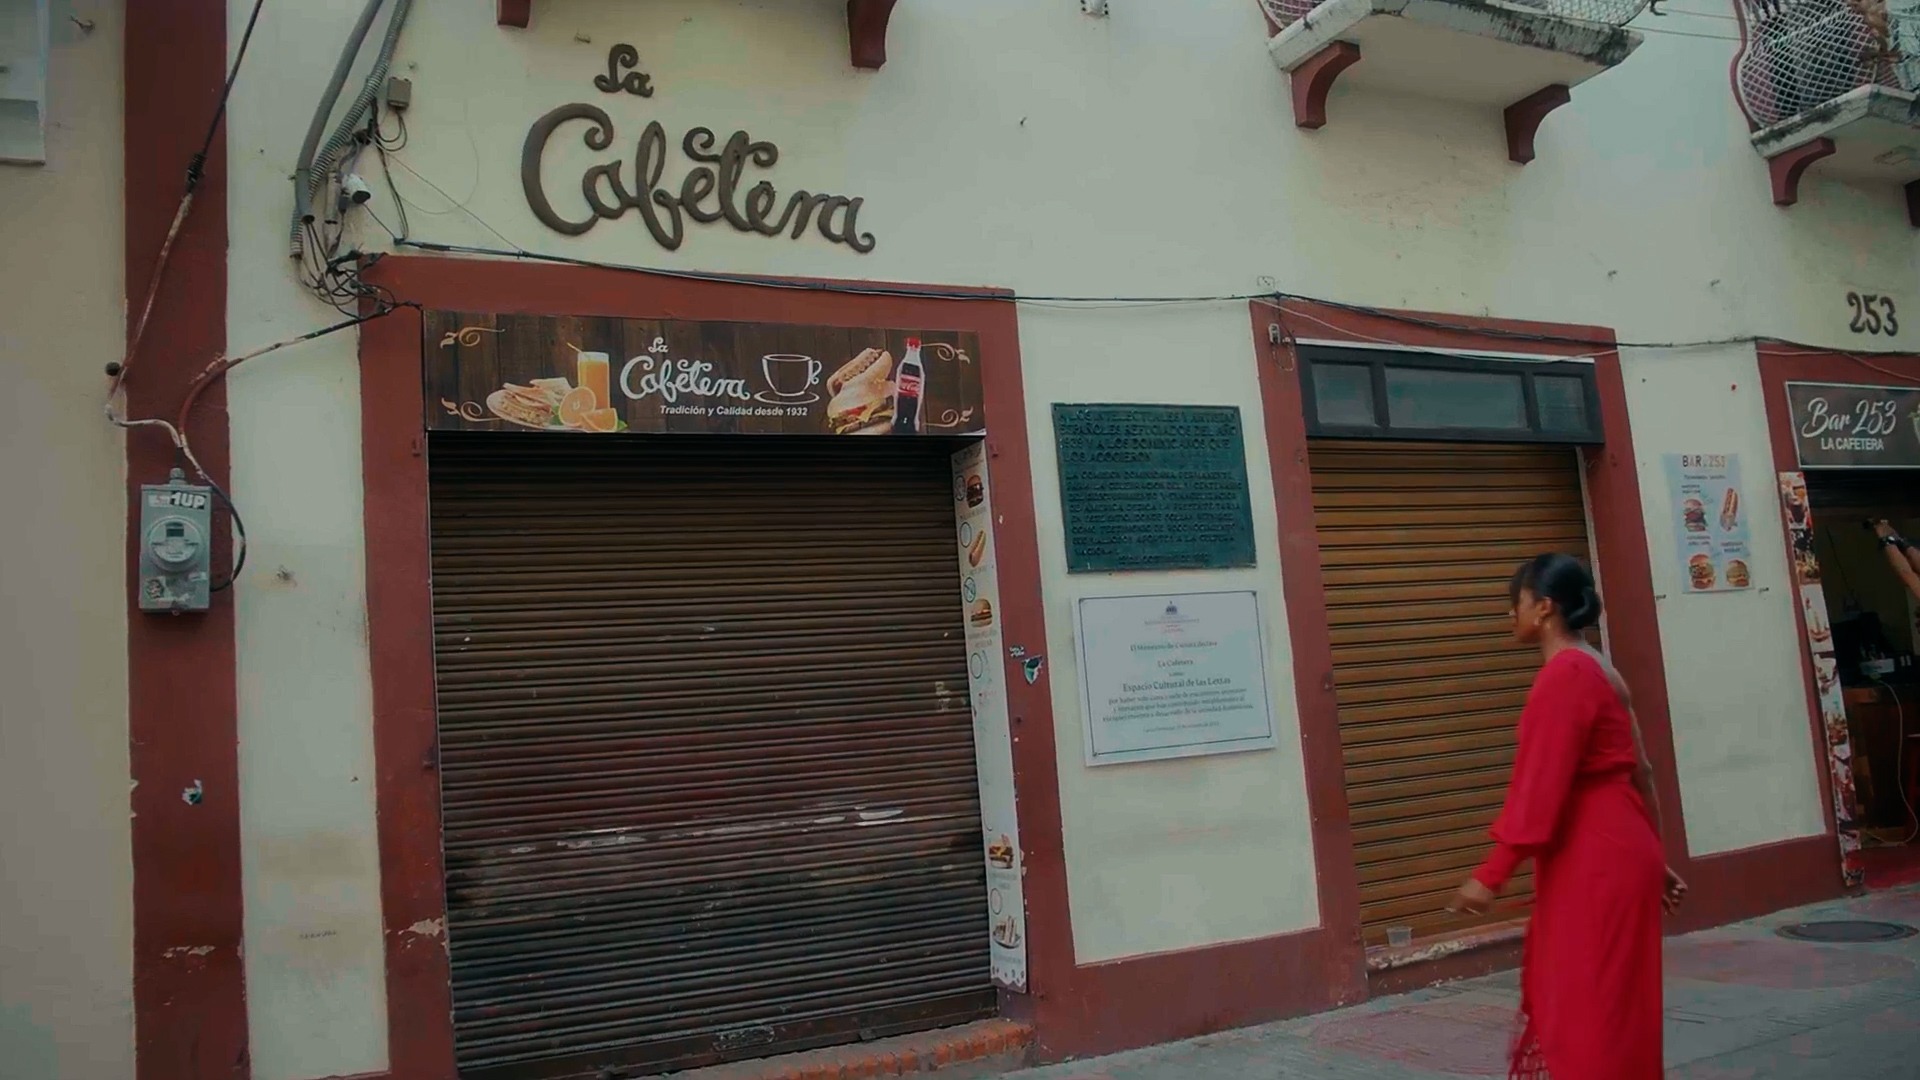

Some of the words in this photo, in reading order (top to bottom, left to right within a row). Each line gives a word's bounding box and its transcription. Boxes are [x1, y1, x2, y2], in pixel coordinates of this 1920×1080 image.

[594, 43, 654, 98] La
[521, 102, 876, 253] Cafetera
[1847, 291, 1899, 337] 253
[648, 336, 669, 354] La
[619, 355, 751, 403] Cafetera
[660, 404, 706, 416] Tradición
[708, 406, 714, 417] y
[716, 405, 753, 416] Calidad
[754, 406, 784, 417] desde
[786, 406, 808, 417] 1932
[1801, 397, 1851, 438] Bar
[1851, 399, 1897, 435] 253
[1820, 437, 1835, 450] LA
[1835, 437, 1885, 451] CAFETERA
[1123, 681, 1153, 693] Espacio
[1153, 679, 1185, 690] Cultural
